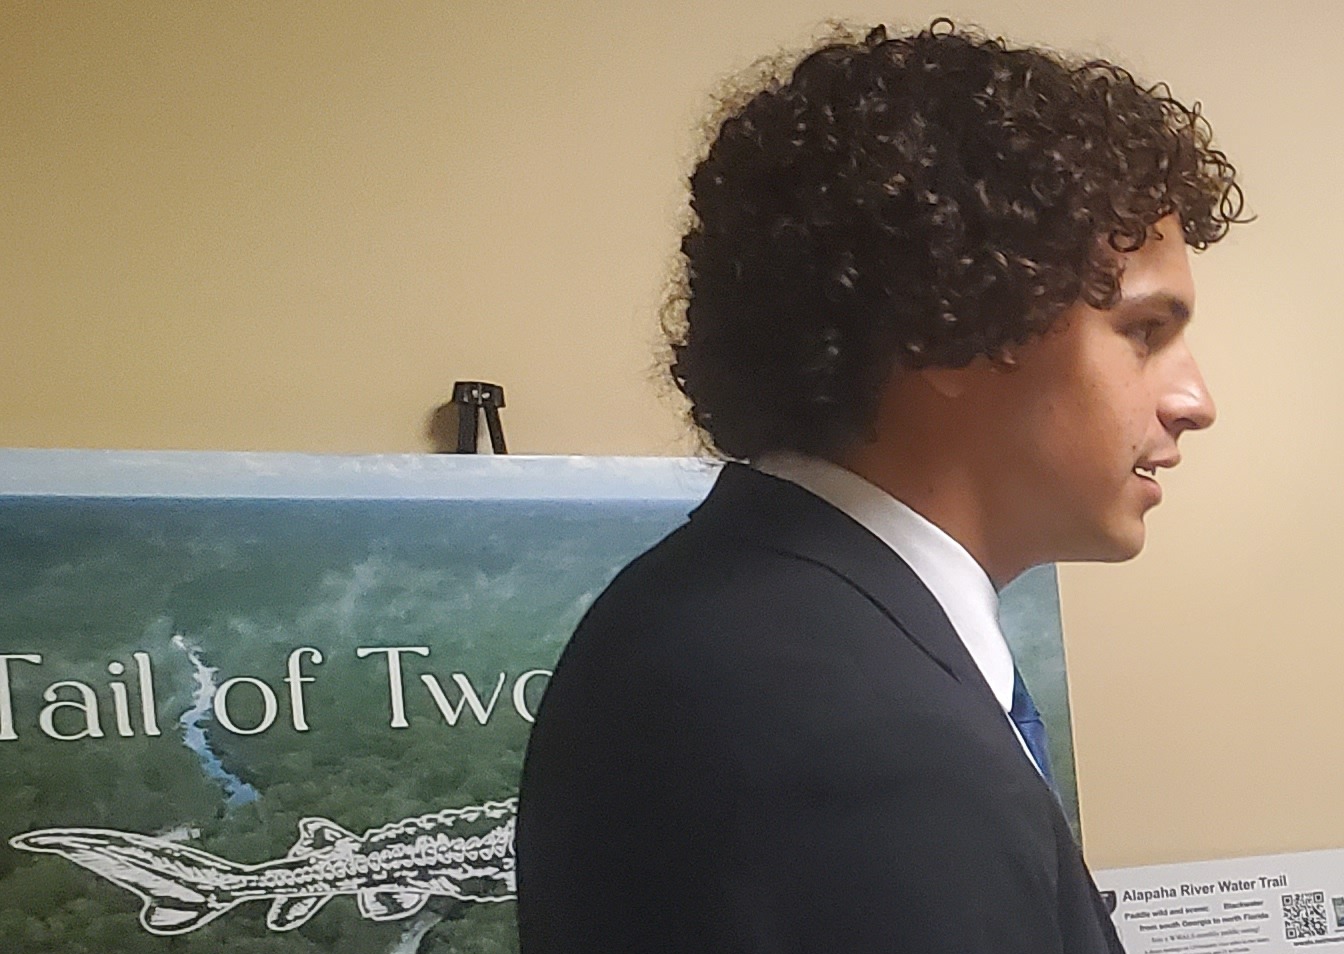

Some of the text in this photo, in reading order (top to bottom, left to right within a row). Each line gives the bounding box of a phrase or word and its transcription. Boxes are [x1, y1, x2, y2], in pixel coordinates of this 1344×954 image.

[0, 646, 554, 740] Tail of Two
[1122, 875, 1288, 902] Alapaha River Water Trail
[1181, 918, 1212, 928] Georgia
[1243, 912, 1269, 921] Florida
